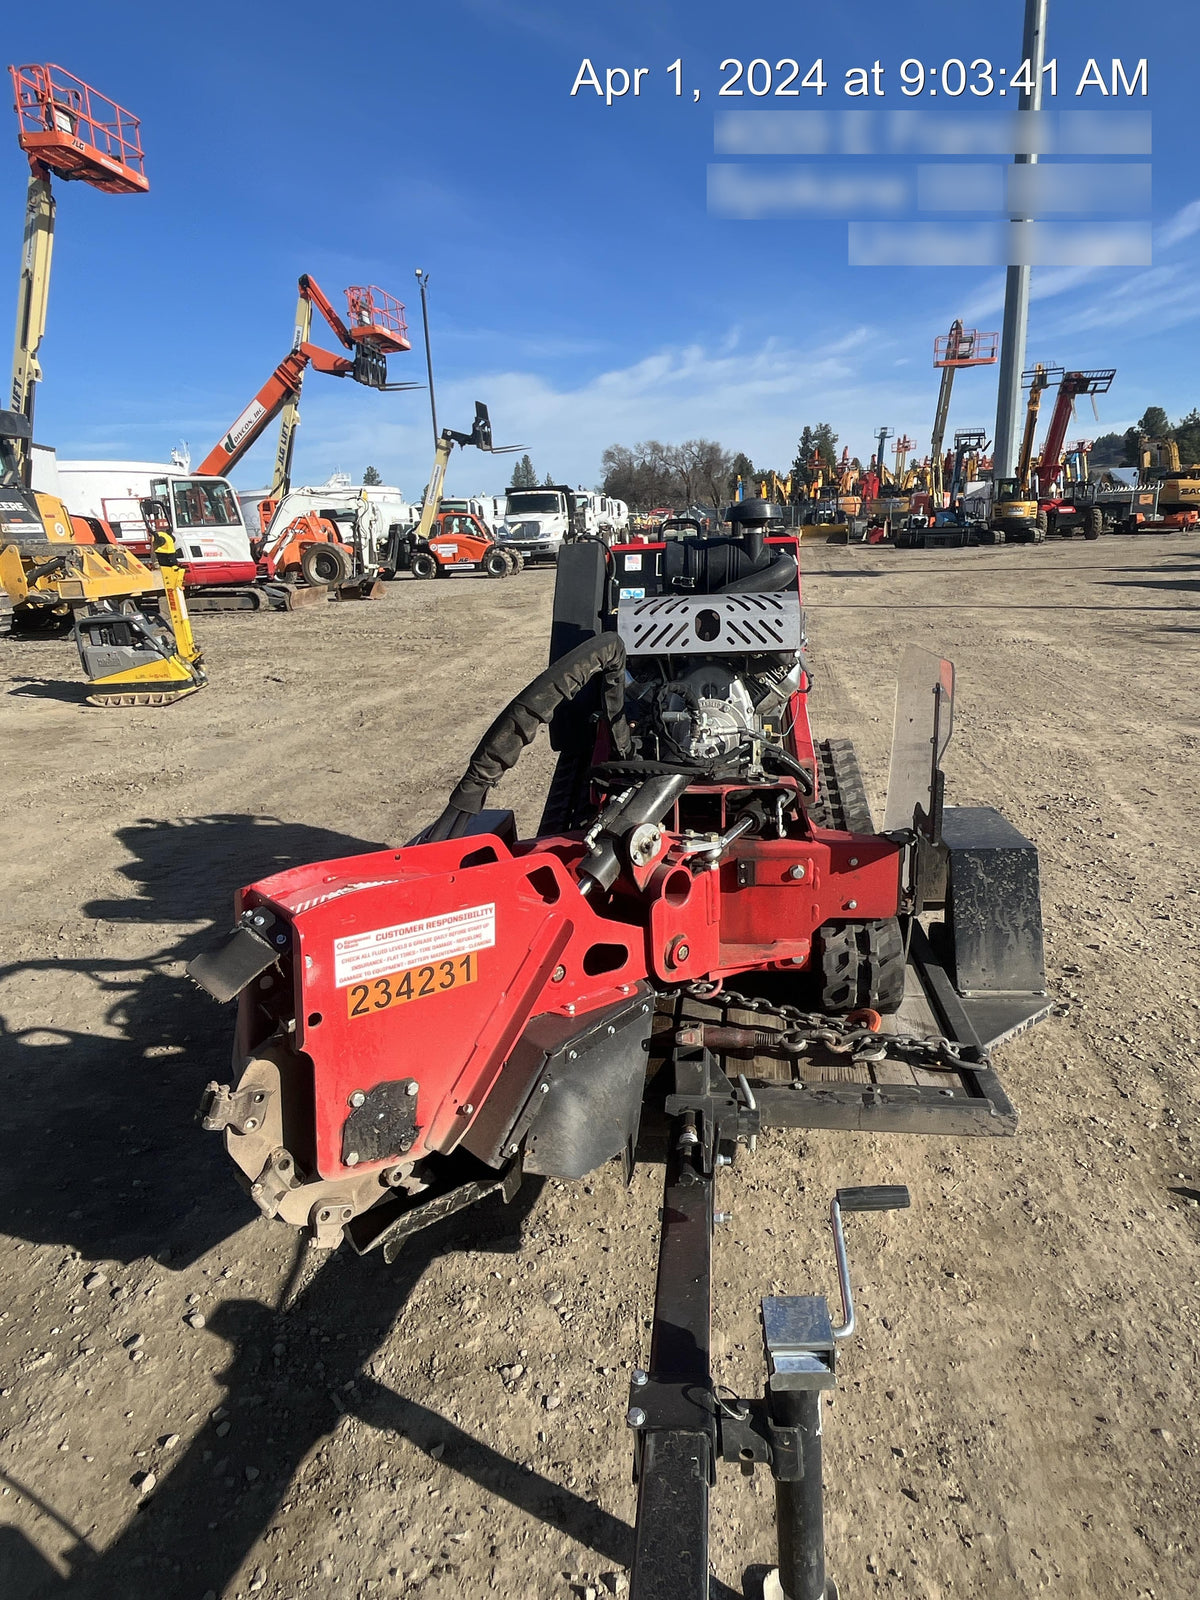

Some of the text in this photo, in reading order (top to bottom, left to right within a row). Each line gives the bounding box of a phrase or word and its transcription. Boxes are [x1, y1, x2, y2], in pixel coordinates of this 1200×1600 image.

[71, 139, 85, 151] JLG
[281, 421, 289, 446] LIFT
[375, 907, 494, 941] CUSTOMER RESPONSIBILITY
[339, 972, 363, 983] DAMAGE
[372, 961, 404, 975] EQUIPMENT
[468, 938, 492, 949] CLEANING
[341, 955, 360, 964] CHECK
[388, 943, 408, 952] LEVELS
[413, 937, 433, 946] GREASE
[448, 928, 466, 937] BEFORE
[467, 924, 482, 932] START
[351, 958, 383, 971] INSURANCE
[386, 954, 399, 962] FLAT
[432, 941, 453, 950] DAMAGE
[350, 954, 471, 1017] 234231
